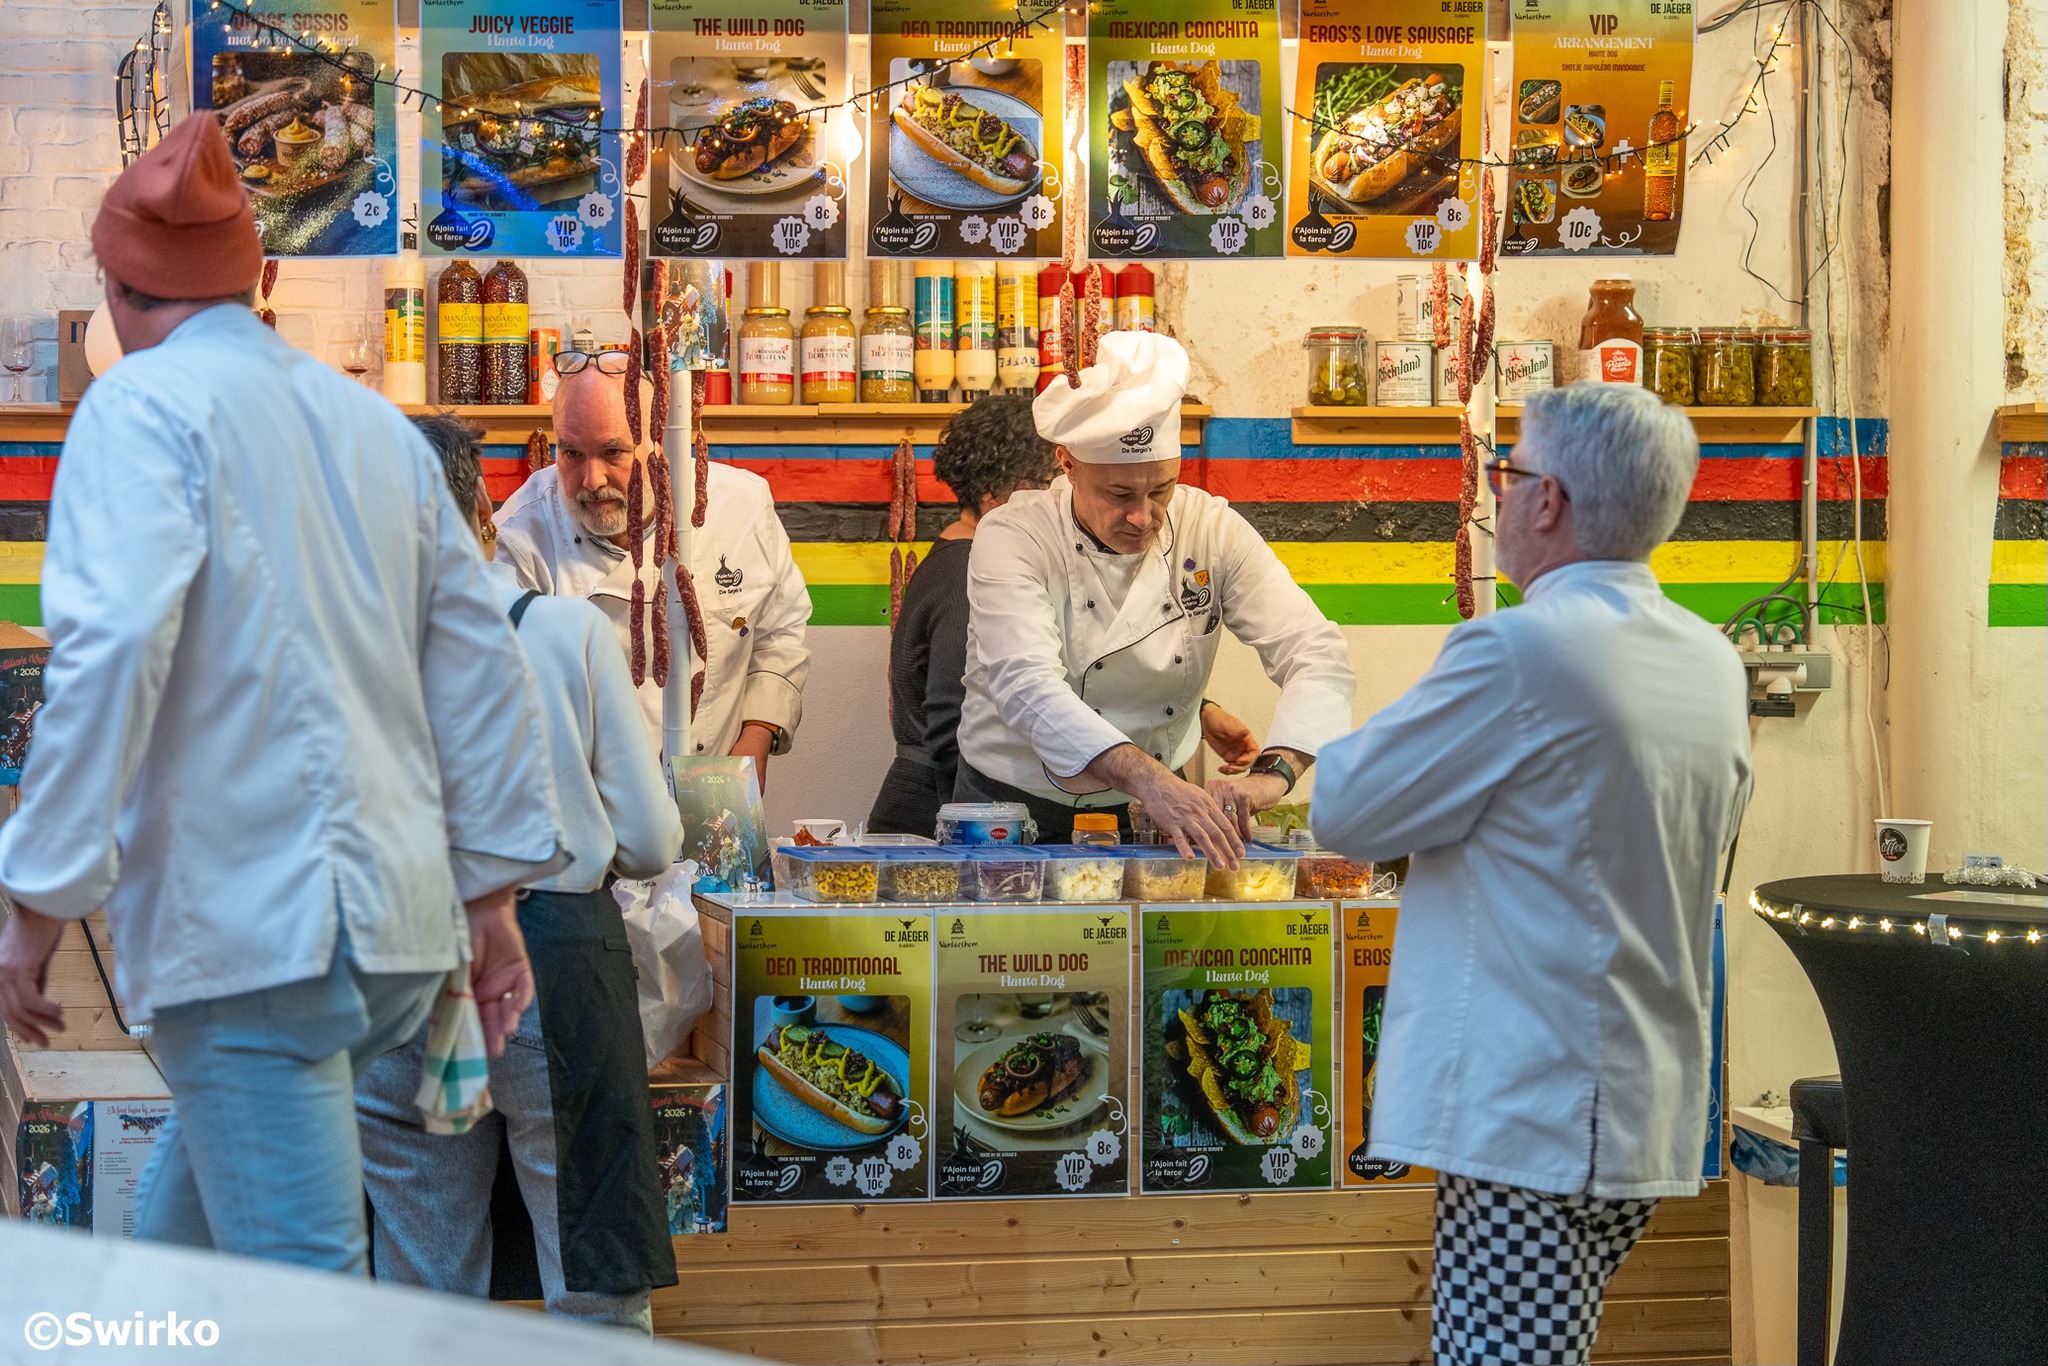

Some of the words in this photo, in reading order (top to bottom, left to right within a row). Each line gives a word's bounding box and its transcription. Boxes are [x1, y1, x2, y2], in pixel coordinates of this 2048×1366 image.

[1232, 0, 1243, 9] DE
[1245, 0, 1275, 10] JAEGER
[1441, 2, 1451, 12] DE
[1453, 1, 1483, 13] JAEGER
[1650, 3, 1661, 14] DE
[1662, 3, 1692, 14] JAEGER
[468, 15, 514, 33] JUICY
[519, 16, 574, 34] VEGGIE
[693, 18, 722, 36] THE
[728, 18, 768, 36] WILD
[774, 18, 805, 37] DOG
[901, 20, 930, 39] DEN
[936, 21, 1033, 39] TRADITIONAL
[1109, 21, 1179, 39] MEXICAN
[1184, 20, 1259, 39] CONCHITA
[1589, 15, 1618, 35] VIP
[1309, 25, 1361, 43] EROS'S
[1367, 26, 1402, 43] LOVE
[1407, 26, 1475, 44] SAUSAGE
[487, 35, 525, 47] Haute
[528, 35, 555, 49] Dog
[715, 39, 753, 51] Haute
[755, 39, 781, 53] Dog
[933, 40, 971, 53] Haute
[1553, 37, 1656, 49] ARRANGEMENT
[1150, 42, 1188, 54] Haute
[1190, 42, 1216, 56] Dog
[1360, 45, 1396, 57] Haute
[1398, 45, 1423, 59] Dog
[1588, 50, 1605, 58] HAUTE
[1607, 50, 1618, 58] DOG
[589, 204, 604, 217] 8€
[815, 205, 830, 220] 8€
[1032, 205, 1047, 220] 8€
[1252, 205, 1267, 219] 8€
[1447, 208, 1462, 222] 8€
[456, 225, 468, 233] fait
[555, 220, 577, 236] VIP
[683, 226, 696, 234] fait
[781, 223, 802, 237] VIP
[901, 226, 914, 234] fait
[998, 223, 1019, 237] VIP
[1121, 228, 1134, 236] fait
[1218, 223, 1240, 237] VIP
[1319, 226, 1332, 234] fait
[1414, 224, 1435, 239] VIP
[1568, 221, 1592, 238] 10€
[435, 233, 443, 241] la
[444, 233, 463, 241] farce
[663, 235, 670, 243] la
[671, 235, 690, 243] farce
[784, 238, 800, 249] 10€
[881, 235, 888, 243] la
[889, 235, 908, 243] farce
[1001, 238, 1017, 249] 10€
[1101, 237, 1109, 245] la
[1110, 237, 1129, 245] farce
[1222, 238, 1238, 249] 10€
[1299, 235, 1307, 243] la
[1308, 235, 1327, 243] farce
[1417, 239, 1433, 250] 10€
[1378, 354, 1421, 386] Rheinland
[1505, 354, 1549, 386] Rheinland
[20, 667, 41, 677] 2026
[707, 776, 725, 784] 2026
[1083, 928, 1094, 940] DE
[1095, 927, 1127, 939] JAEGER
[1286, 924, 1297, 936] DE
[1299, 923, 1329, 935] JAEGER
[884, 930, 896, 942] DE
[897, 930, 929, 943] JAEGER
[978, 954, 1007, 973] THE
[1012, 953, 1053, 973] WILD
[1058, 953, 1089, 972] DOG
[1163, 948, 1234, 968] MEXICAN
[1239, 947, 1312, 967] CONCHITA
[1354, 948, 1391, 967] EROS
[766, 957, 796, 976] DEN
[802, 957, 902, 976] TRADITIONAL
[1000, 975, 1037, 988] Haute
[1040, 974, 1065, 989] Dog
[1206, 970, 1242, 983] Haute
[1245, 970, 1270, 984] Dog
[800, 977, 838, 990] Haute
[840, 977, 866, 991] Dog
[664, 1108, 685, 1117] 2026
[29, 1124, 50, 1134] 2026
[1097, 1140, 1112, 1155] 8€
[1301, 1135, 1316, 1149] 8€
[897, 1145, 912, 1160] 8€
[1064, 1159, 1085, 1173] VIP
[1175, 1160, 1188, 1168] fait
[1269, 1152, 1291, 1167] VIP
[766, 1169, 779, 1177] fait
[863, 1163, 885, 1178] VIP
[968, 1165, 981, 1173] fait
[1155, 1168, 1163, 1176] la
[1163, 1168, 1182, 1177] farce
[1272, 1168, 1288, 1180] 10€
[745, 1178, 753, 1186] la
[753, 1178, 773, 1186] farce
[867, 1178, 883, 1191] 10€
[947, 1174, 955, 1182] la
[956, 1174, 975, 1182] farce
[1067, 1173, 1083, 1185] 10€
